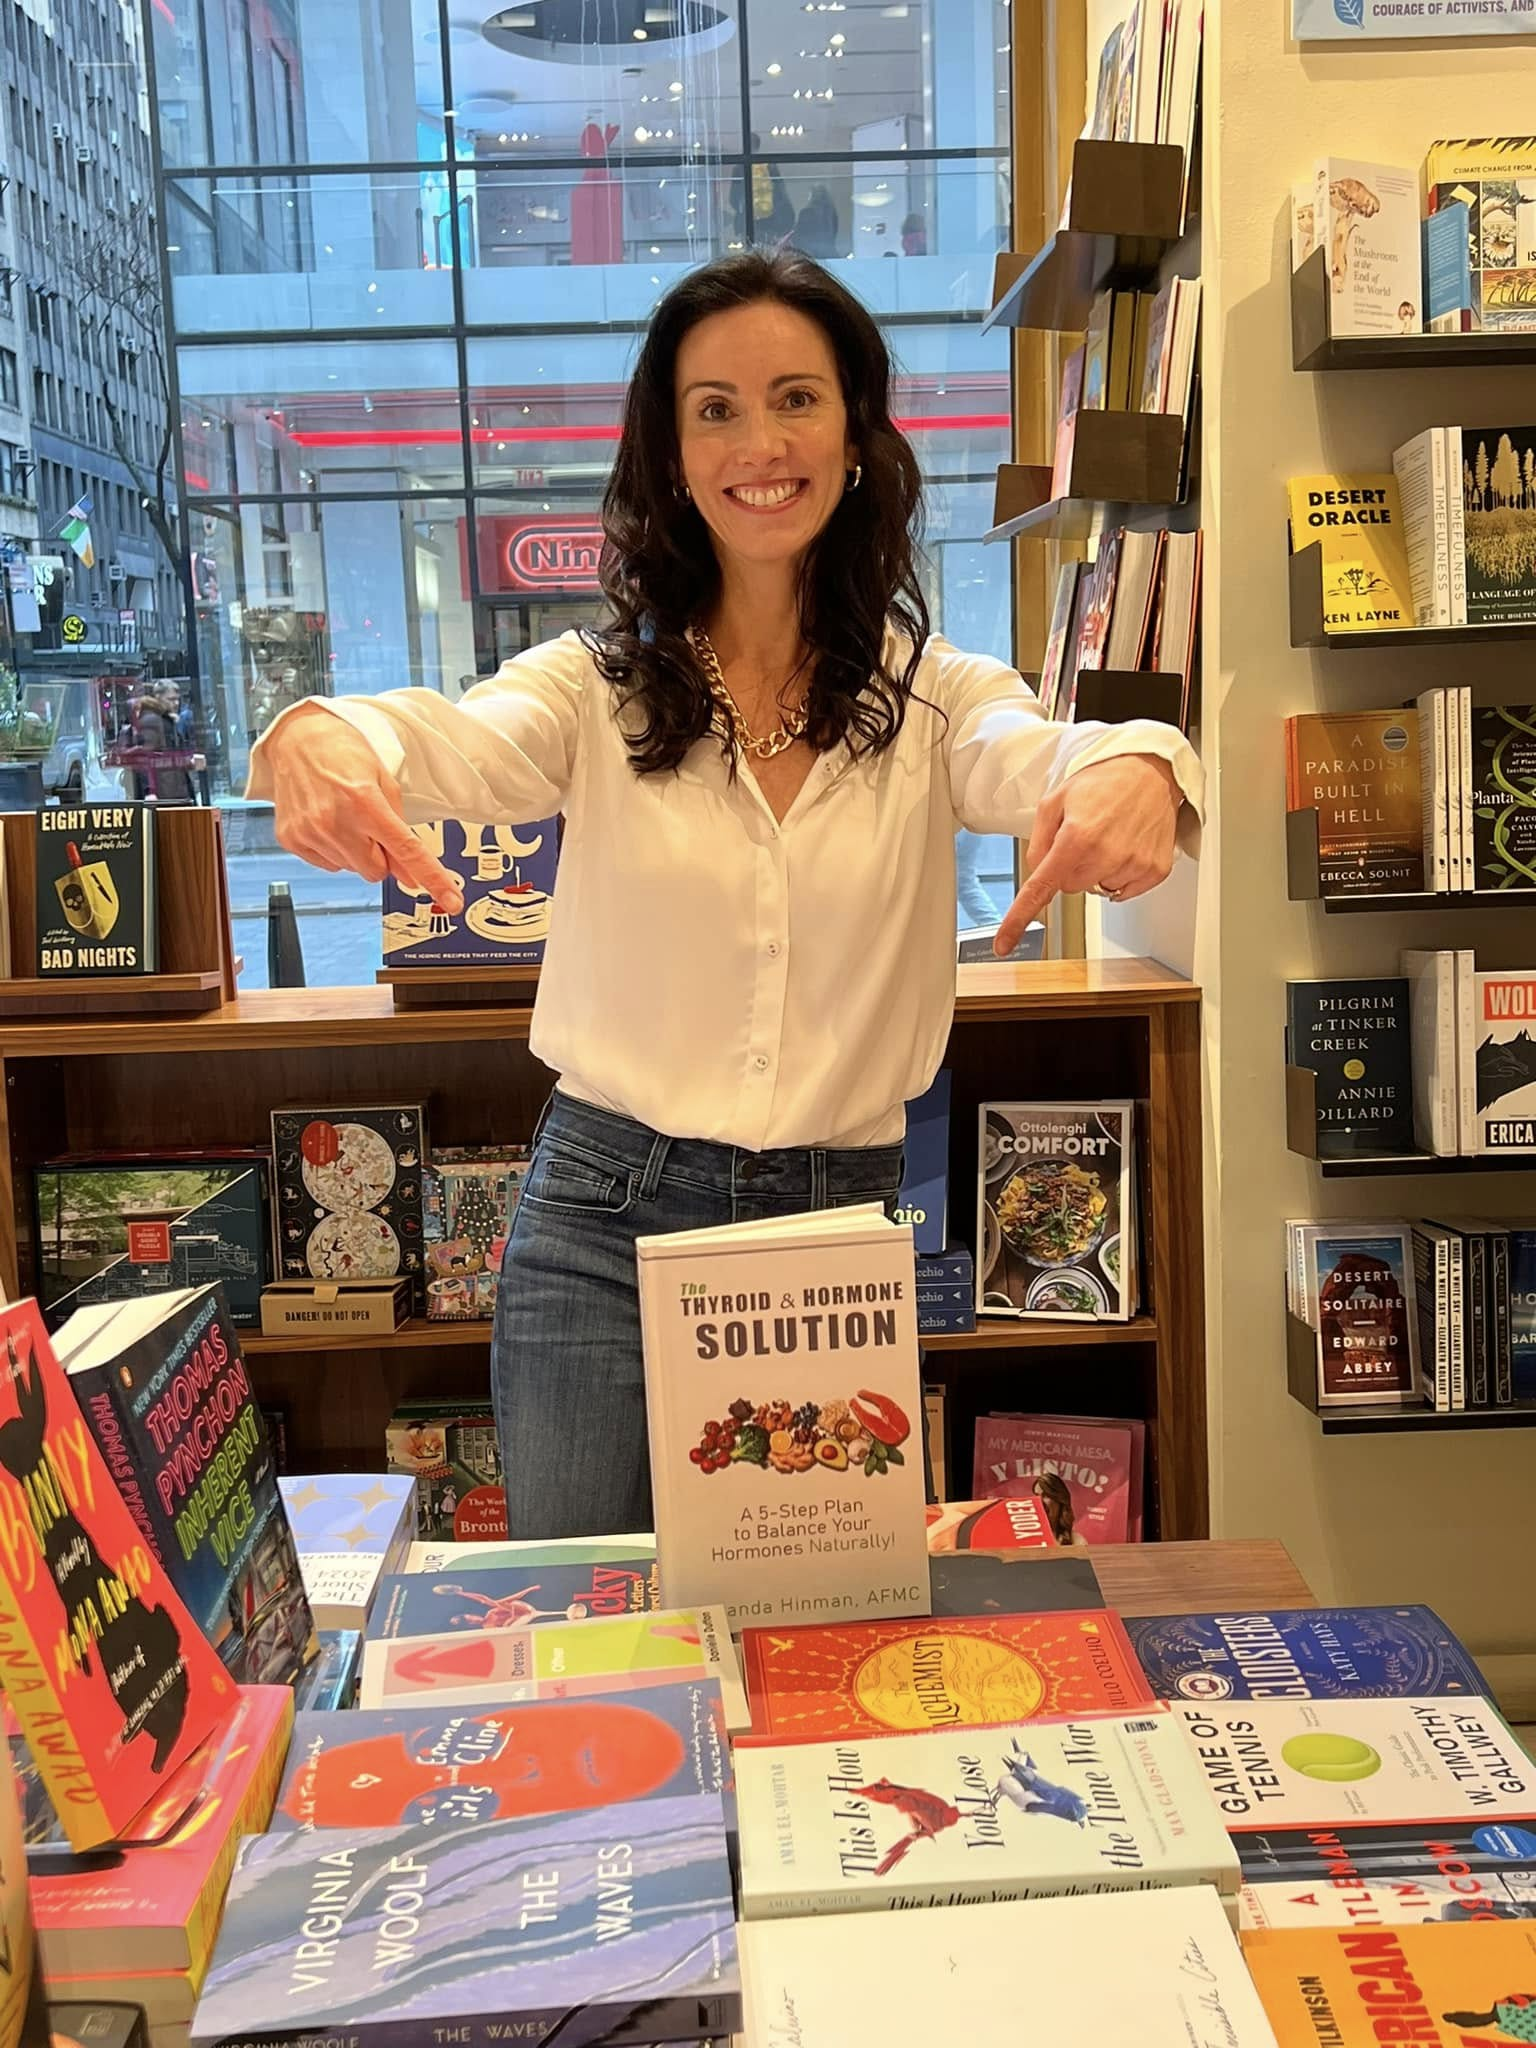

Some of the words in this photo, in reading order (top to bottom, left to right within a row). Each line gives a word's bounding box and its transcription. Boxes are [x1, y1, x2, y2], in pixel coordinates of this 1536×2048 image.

[1373, 3, 1424, 16] COURAGE
[1428, 2, 1441, 14] OF
[1446, 1, 1507, 14] ACTIVISTS,
[1511, 0, 1534, 11] AND
[1354, 247, 1398, 262] Mushroom
[1354, 270, 1370, 282] End
[1366, 285, 1392, 298] World
[1308, 489, 1386, 506] DESERT
[1308, 509, 1391, 527] ORACLE
[1434, 486, 1448, 591] TIMEFULNESS
[1451, 496, 1465, 601] TIMEFULNESS
[1472, 589, 1520, 600] LANGUAGE
[1523, 588, 1536, 597] OF
[1357, 610, 1400, 623] LAYNE
[1482, 613, 1505, 621] KATIE
[1351, 733, 1365, 747] A
[1306, 757, 1409, 775] PARADISE
[1313, 783, 1372, 800] BUILT
[1384, 782, 1405, 796] IN
[41, 810, 87, 831] EIGHT
[92, 808, 134, 829] VERY
[1334, 807, 1386, 824] HELL
[1320, 871, 1364, 881] EBECCA
[1369, 868, 1411, 879] SOLNIT
[41, 949, 73, 969] BAD
[78, 947, 136, 968] NIGHTS
[1319, 996, 1394, 1011] PILGRIM
[1312, 1022, 1323, 1032] at
[1327, 1017, 1397, 1031] TINKER
[1311, 1038, 1369, 1051] CREEK
[1337, 1086, 1396, 1100] ANNIE
[1020, 1121, 1087, 1136] Ottolenghi
[1490, 1124, 1534, 1143] ERICA
[998, 1135, 1110, 1156] COMFORT
[680, 1282, 707, 1296] The
[1333, 1271, 1390, 1283] DESERT
[680, 1292, 771, 1316] THYROID
[780, 1293, 795, 1309] &
[803, 1281, 903, 1307] HORMONE
[1323, 1298, 1403, 1312] SOLITAIRE
[285, 1311, 321, 1322] DANGER!
[323, 1312, 333, 1321] DO
[335, 1311, 349, 1321] NOT
[351, 1311, 371, 1321] OPEN
[696, 1309, 896, 1360] SOLUTION
[1333, 1335, 1399, 1348] EDWARD
[131, 1392, 150, 1417] NEW
[150, 1371, 170, 1396] YORK
[167, 1339, 188, 1370] TIMES
[185, 1297, 219, 1347] BESTSELLER
[1343, 1362, 1392, 1374] ABBEY
[145, 1323, 228, 1454] THOMAS
[89, 1392, 135, 1478] THOMAS
[155, 1358, 250, 1516] PYNCHON
[988, 1437, 1008, 1449] MY
[1011, 1440, 1072, 1457] MEXICAN
[1076, 1446, 1115, 1462] MESA,
[175, 1404, 260, 1560] INHERENT
[990, 1462, 1008, 1482] Y
[1016, 1458, 1109, 1493] LISTO!
[469, 1498, 485, 1506] The
[480, 1508, 487, 1516] of
[740, 1507, 752, 1522] A
[759, 1503, 818, 1520] 5-Step
[825, 1499, 864, 1515] Plan
[210, 1480, 256, 1567] VICE
[734, 1527, 751, 1541] to
[757, 1521, 826, 1540] Balance
[832, 1517, 871, 1533] Your
[1008, 1499, 1043, 1540] YODER
[711, 1544, 804, 1562] Hormones
[809, 1532, 895, 1553] Naturally!
[318, 1570, 371, 1580] 2024
[727, 1600, 772, 1617] anda
[781, 1594, 859, 1615] Hinman,
[866, 1586, 920, 1606] AFMC
[54, 1597, 104, 1694] MONA
[97, 1546, 151, 1622] AWAD
[1309, 1622, 1341, 1649] HAYS
[706, 1634, 720, 1662] Danielle
[1085, 1636, 1114, 1682] COELHO
[1199, 1647, 1229, 1664] THE
[1213, 1615, 1313, 1700] CLOISTERS
[1326, 1652, 1360, 1682] KATY
[1184, 1711, 1219, 1738] OF
[416, 1717, 467, 1766] Emma
[453, 1719, 503, 1766] Cline
[1061, 1724, 1103, 1767] War
[1410, 1705, 1481, 1781] TIMOTHY
[1450, 1713, 1526, 1794] GALLWEY
[827, 1747, 864, 1792] How
[1134, 1738, 1172, 1808] GLADSTONE
[1226, 1721, 1285, 1801] TENNIS
[954, 1755, 996, 1804] Lose
[1199, 1747, 1251, 1814] GAME
[1085, 1771, 1127, 1828] Time
[1464, 1784, 1497, 1806] W.
[833, 1800, 871, 1821] Is
[964, 1800, 1005, 1849] You
[838, 1826, 878, 1878] This
[1100, 1833, 1144, 1869] the
[520, 1870, 560, 1929] THE
[596, 1842, 633, 1942] WAVES
[888, 1895, 921, 1910] This
[928, 1893, 943, 1908] Is
[1288, 1893, 1319, 1906] A
[1391, 1883, 1431, 1907] IN
[288, 1847, 357, 1996] VIRGINIA
[372, 1854, 428, 1971] WOOLF
[434, 2028, 472, 2043] THE
[486, 2023, 549, 2041] WAVES
